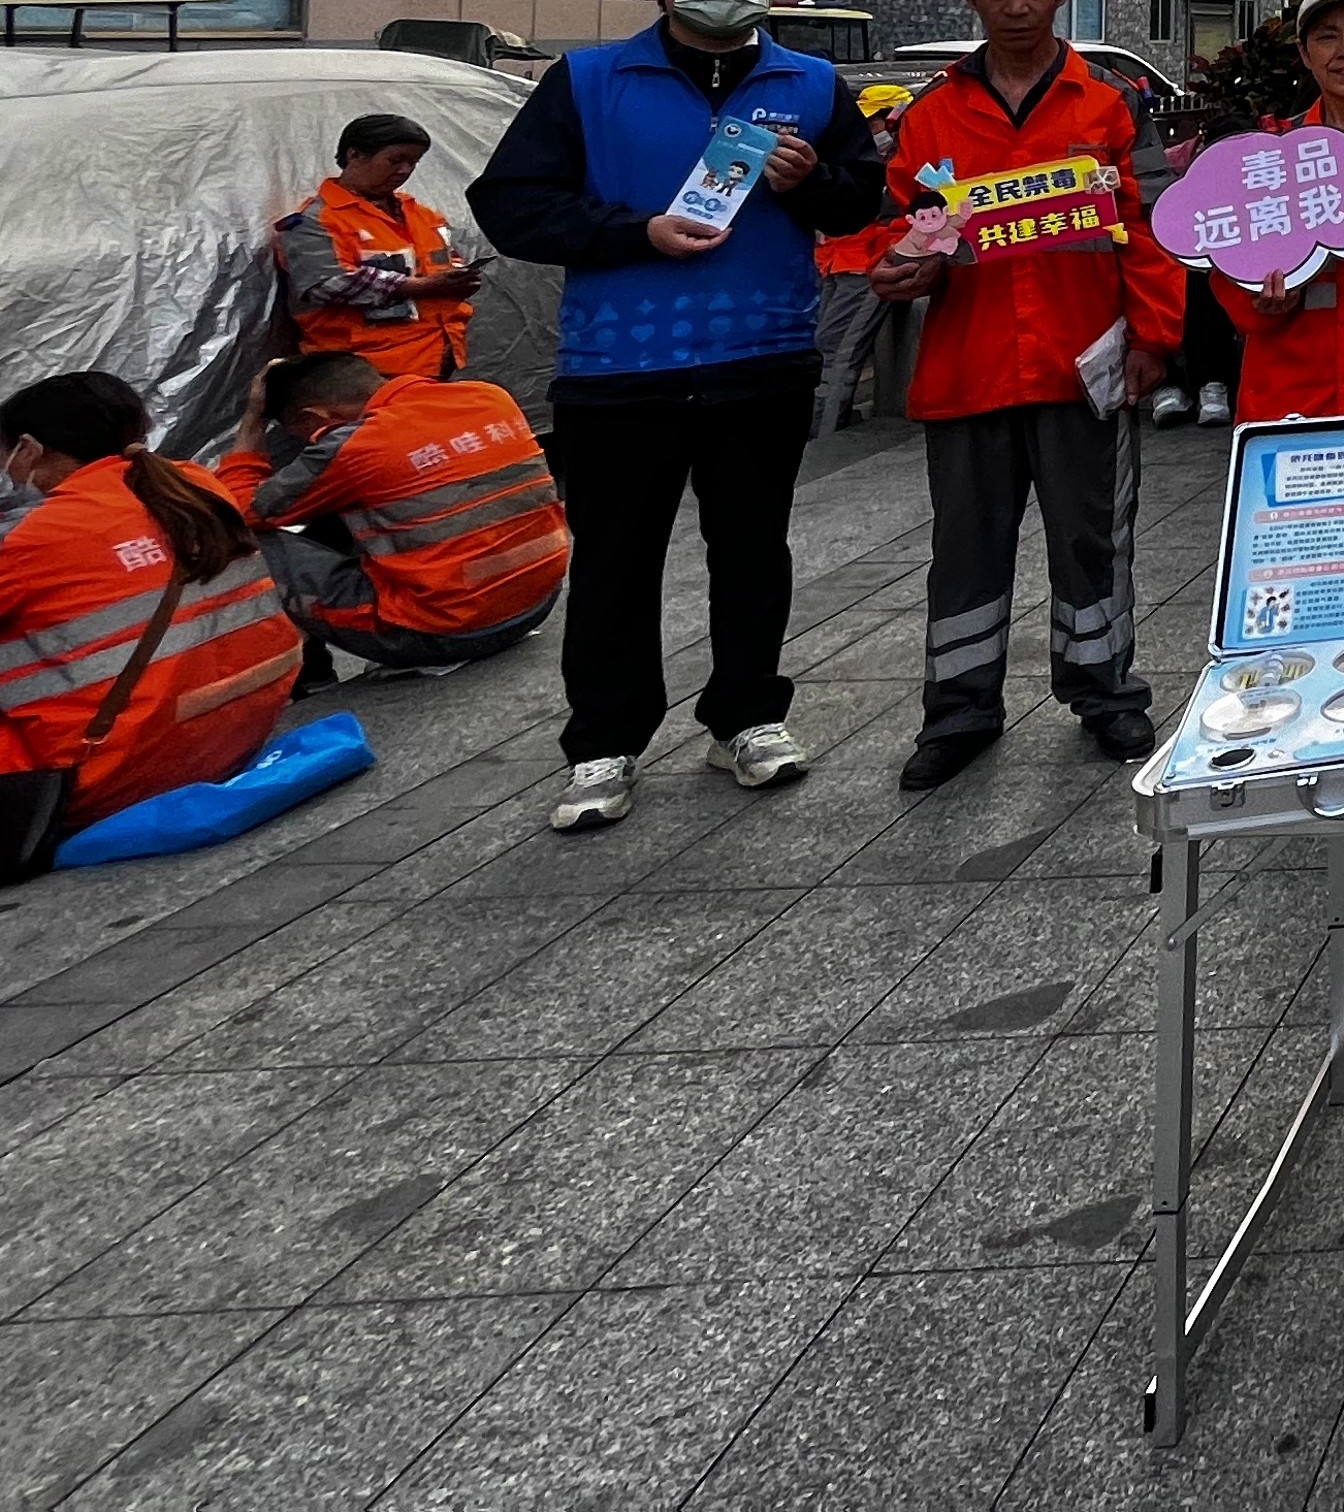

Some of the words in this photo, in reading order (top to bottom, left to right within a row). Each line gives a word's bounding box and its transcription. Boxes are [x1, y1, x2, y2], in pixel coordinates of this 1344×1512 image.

[967, 167, 1077, 208] 全民禁毒
[1240, 137, 1338, 191] 毒品
[977, 204, 1101, 252] 共建幸福
